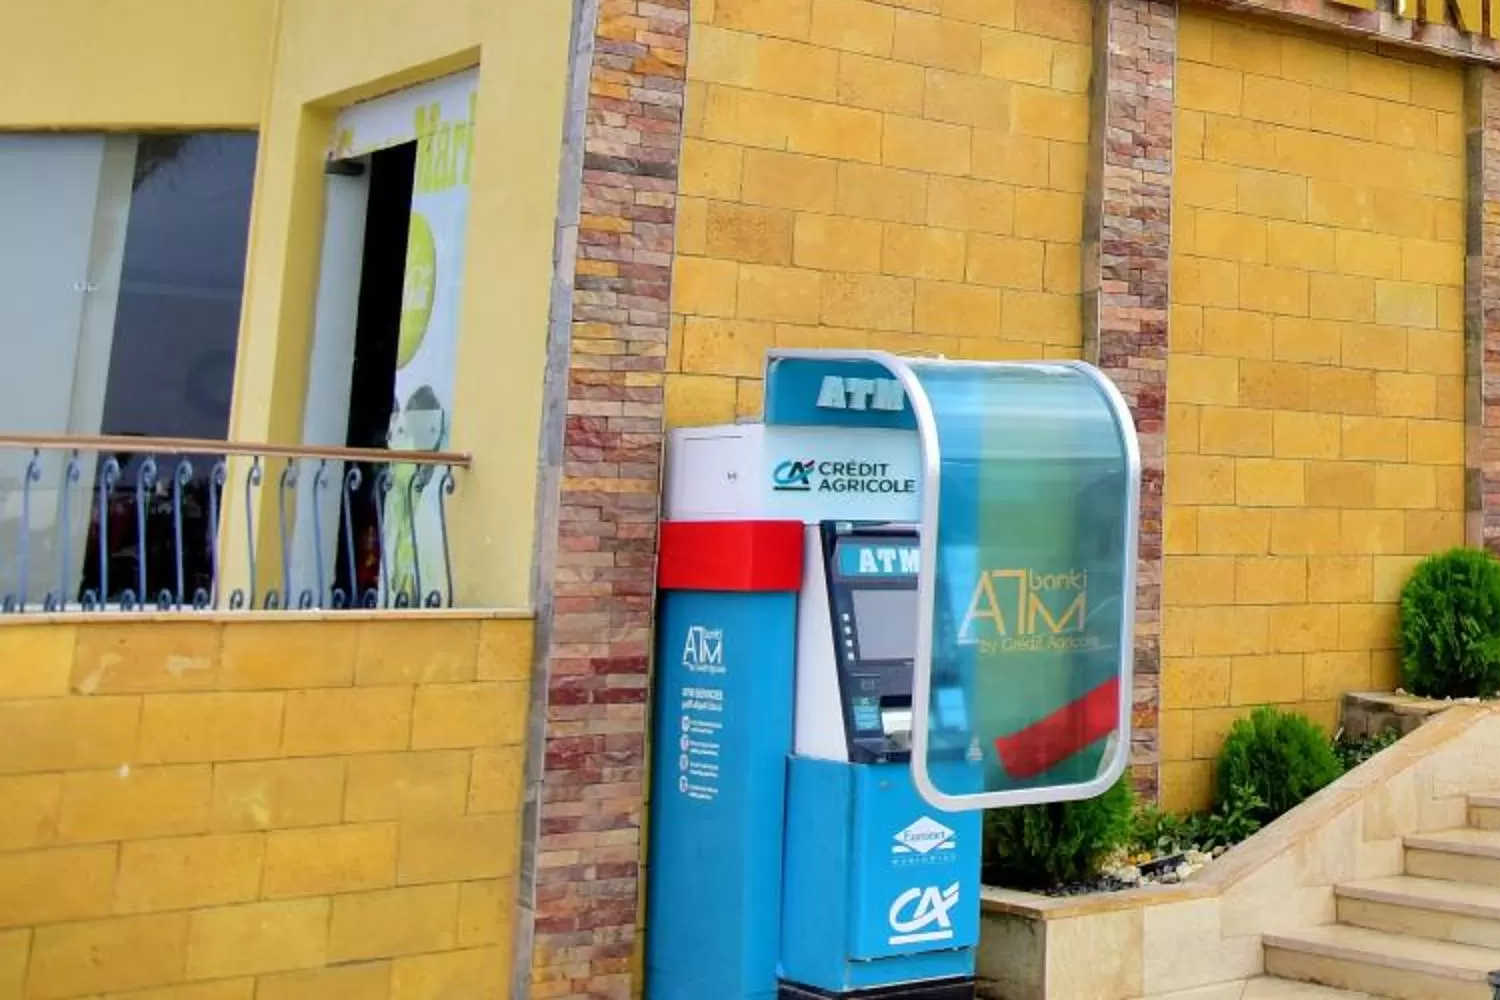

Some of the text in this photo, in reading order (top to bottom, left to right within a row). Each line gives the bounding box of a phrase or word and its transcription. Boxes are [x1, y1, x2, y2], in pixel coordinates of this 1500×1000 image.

[816, 375, 905, 411] ATM
[818, 459, 889, 477] CRÉDIT
[818, 479, 917, 493] AGRICOLE
[859, 546, 920, 573] ATM
